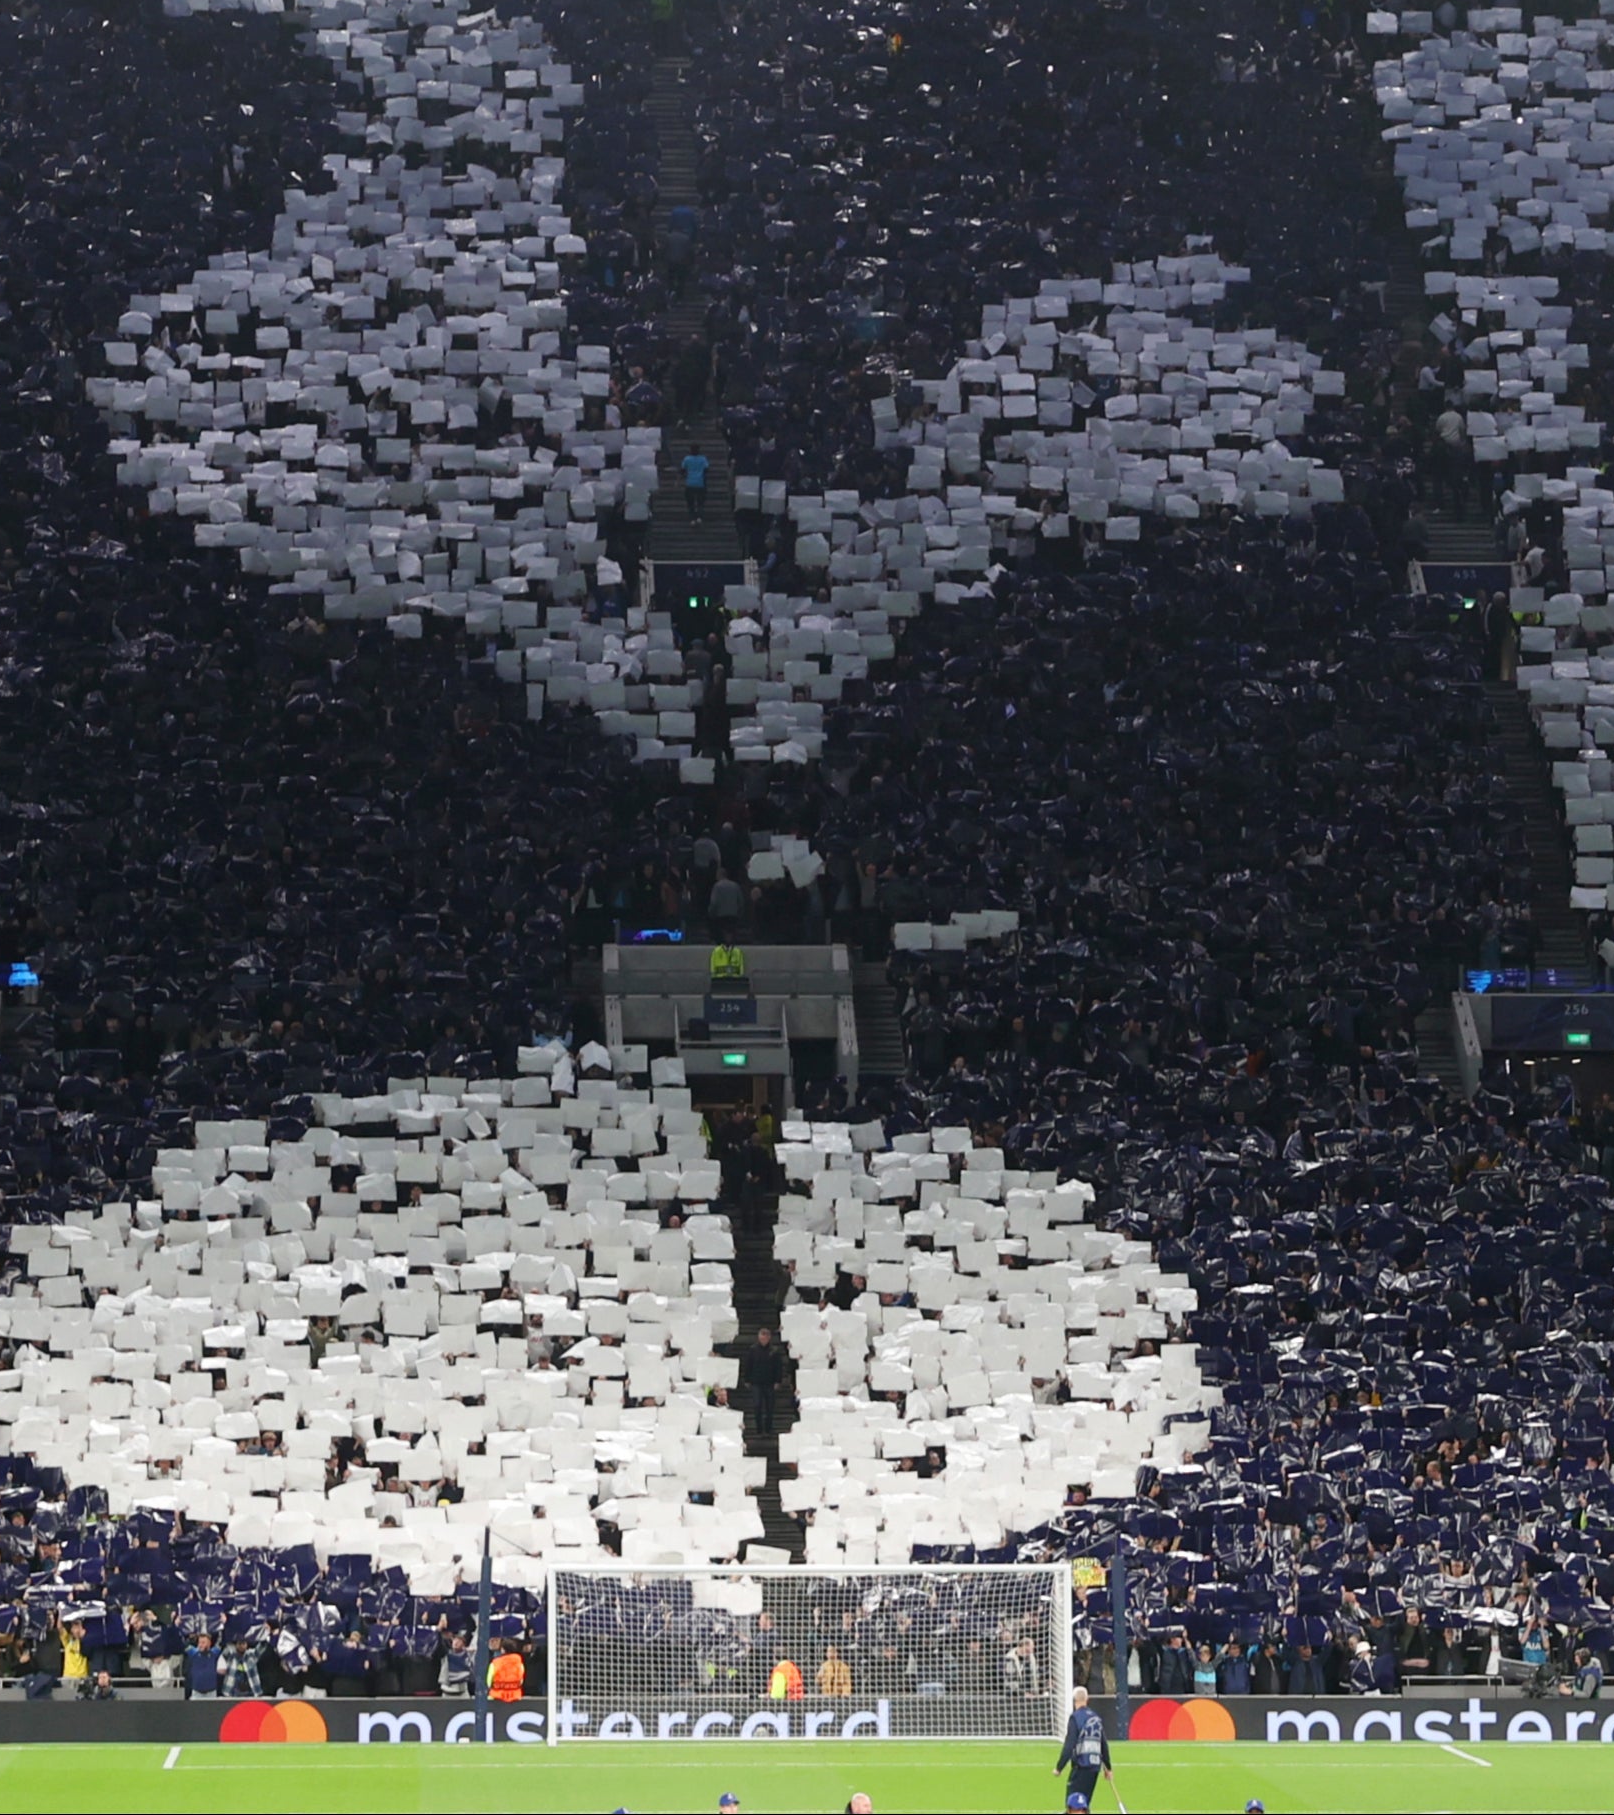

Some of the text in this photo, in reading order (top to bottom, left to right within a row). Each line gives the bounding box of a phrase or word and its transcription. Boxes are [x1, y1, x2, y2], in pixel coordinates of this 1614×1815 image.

[1564, 1003, 1589, 1016] 256
[1526, 1641, 1541, 1650] AIA
[358, 1700, 890, 1743] mastercard
